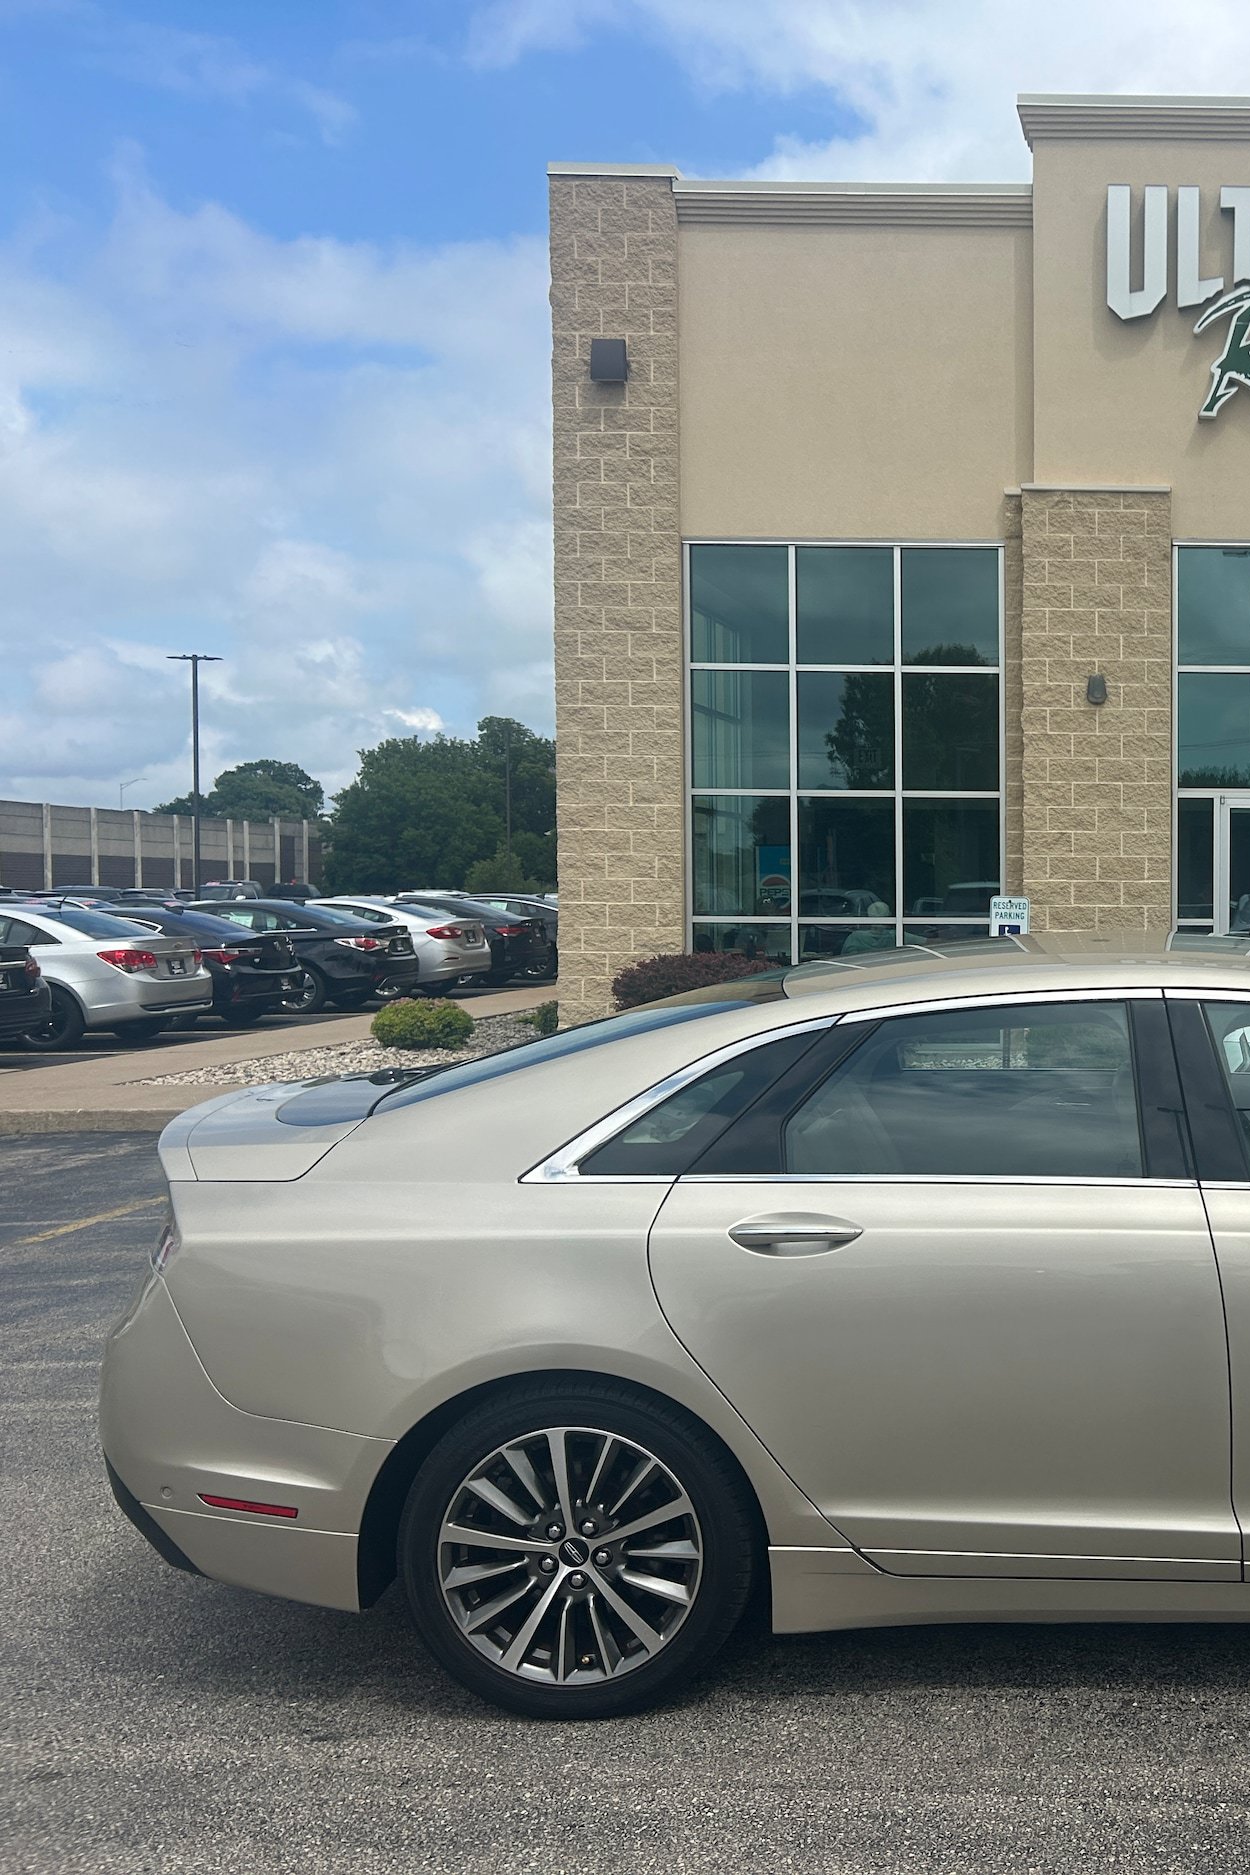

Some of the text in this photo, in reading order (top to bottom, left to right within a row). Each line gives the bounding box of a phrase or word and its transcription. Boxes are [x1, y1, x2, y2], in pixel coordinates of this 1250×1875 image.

[759, 888, 790, 897] PEPS
[993, 901, 1027, 910] RESERVED
[995, 911, 1025, 920] PARKING
